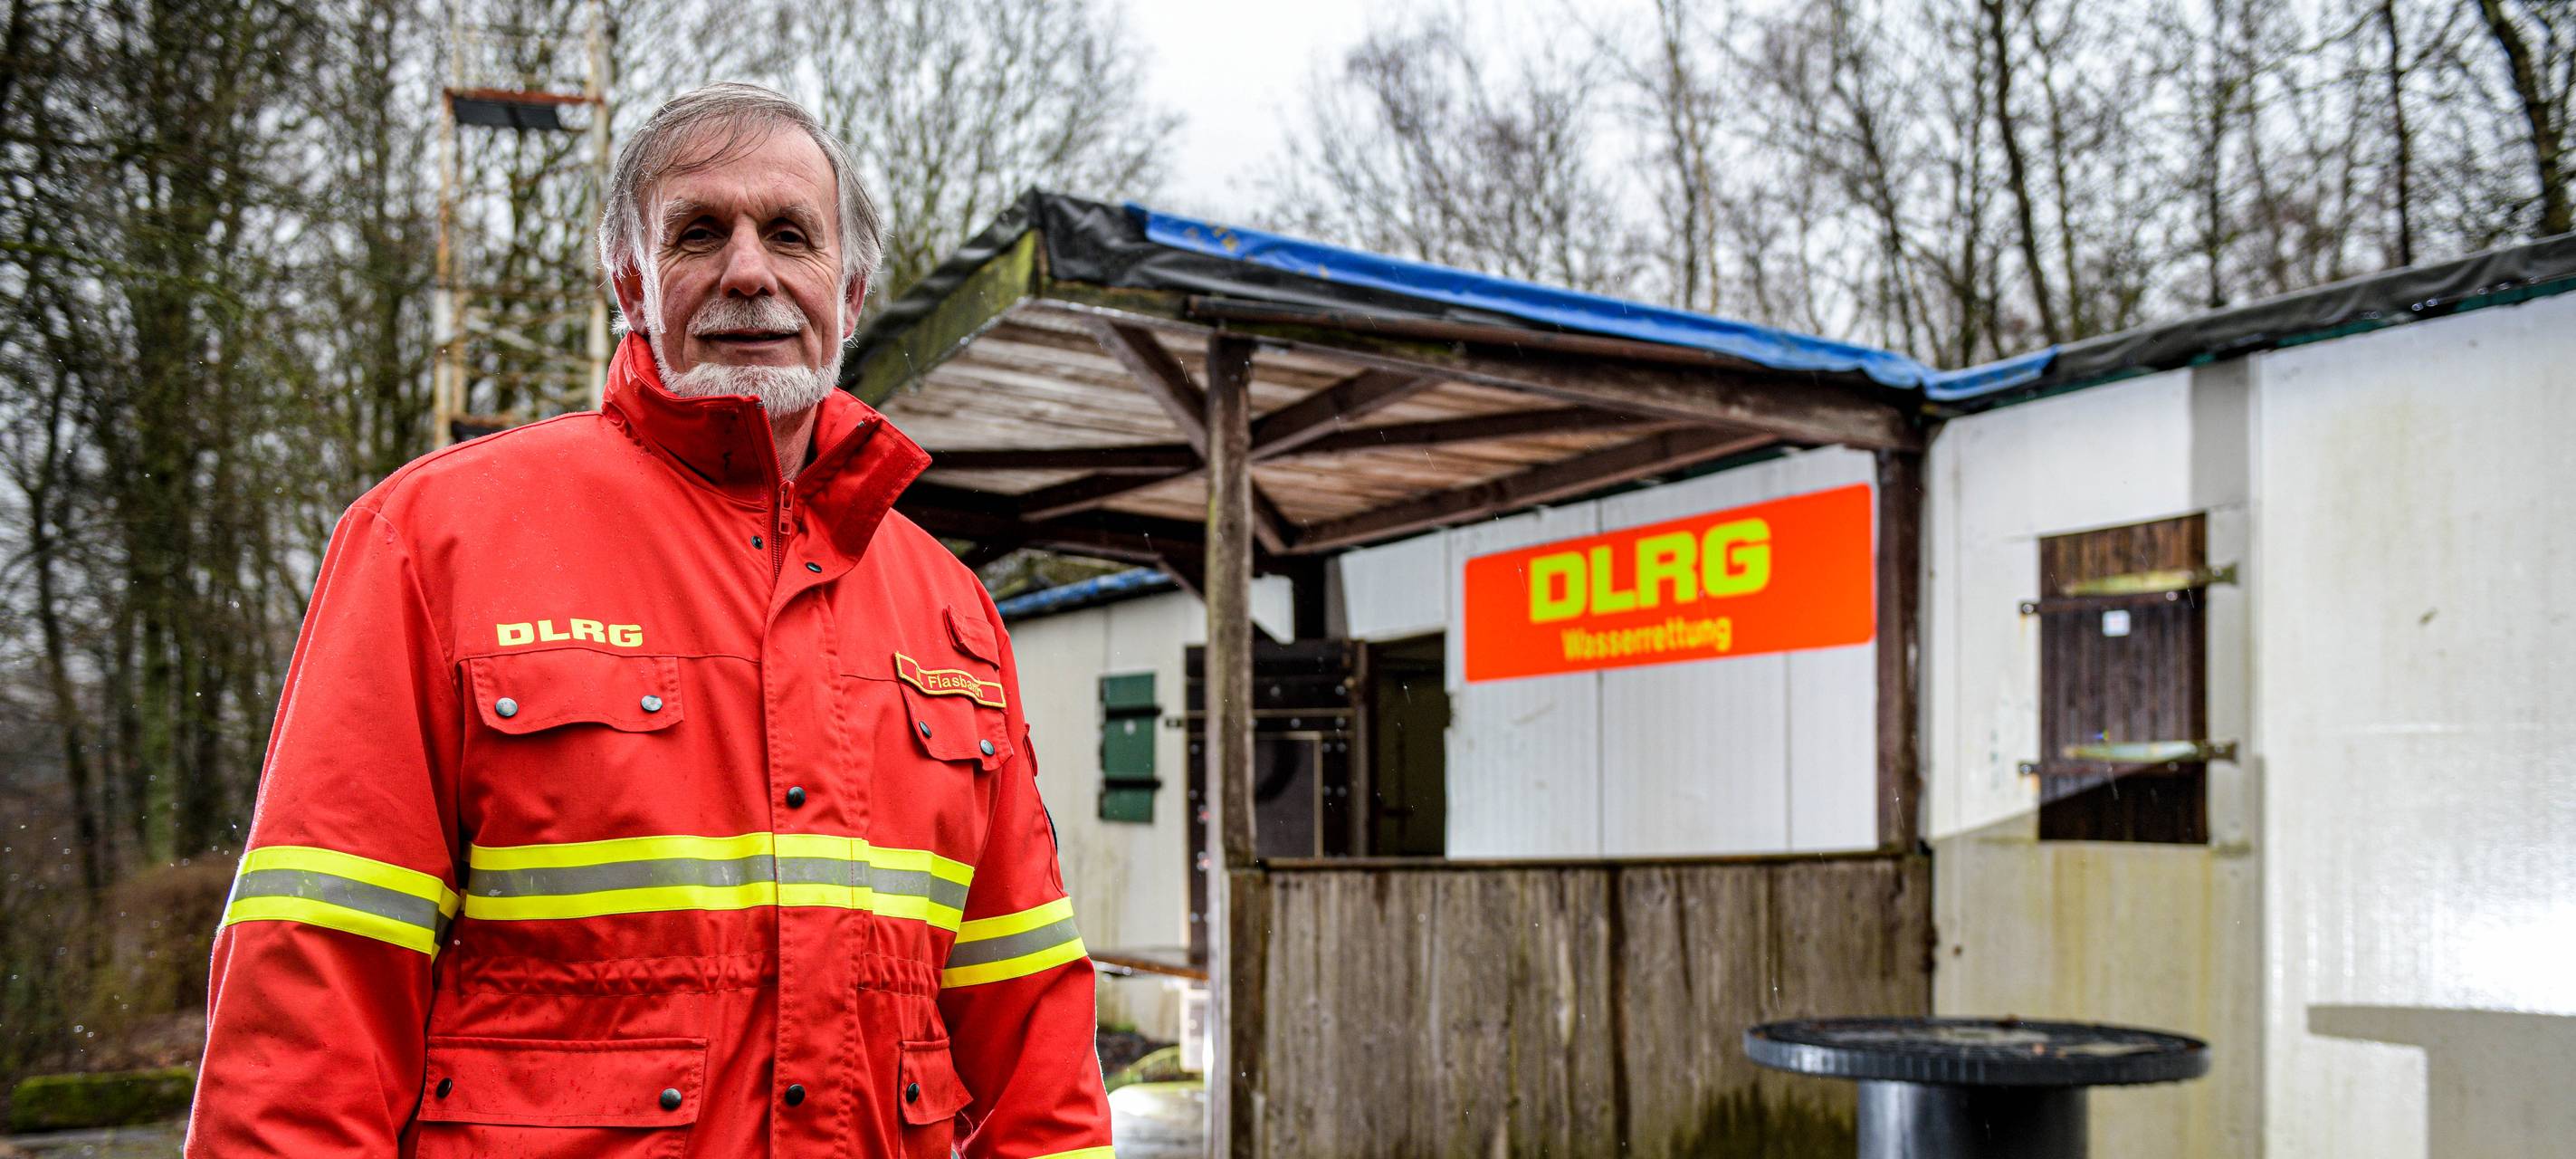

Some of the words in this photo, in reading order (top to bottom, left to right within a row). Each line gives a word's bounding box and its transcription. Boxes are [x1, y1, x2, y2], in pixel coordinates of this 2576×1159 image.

[1530, 518, 1770, 623] DLRG
[497, 618, 644, 647] DLRG
[1562, 618, 1732, 661] Wasserrettung
